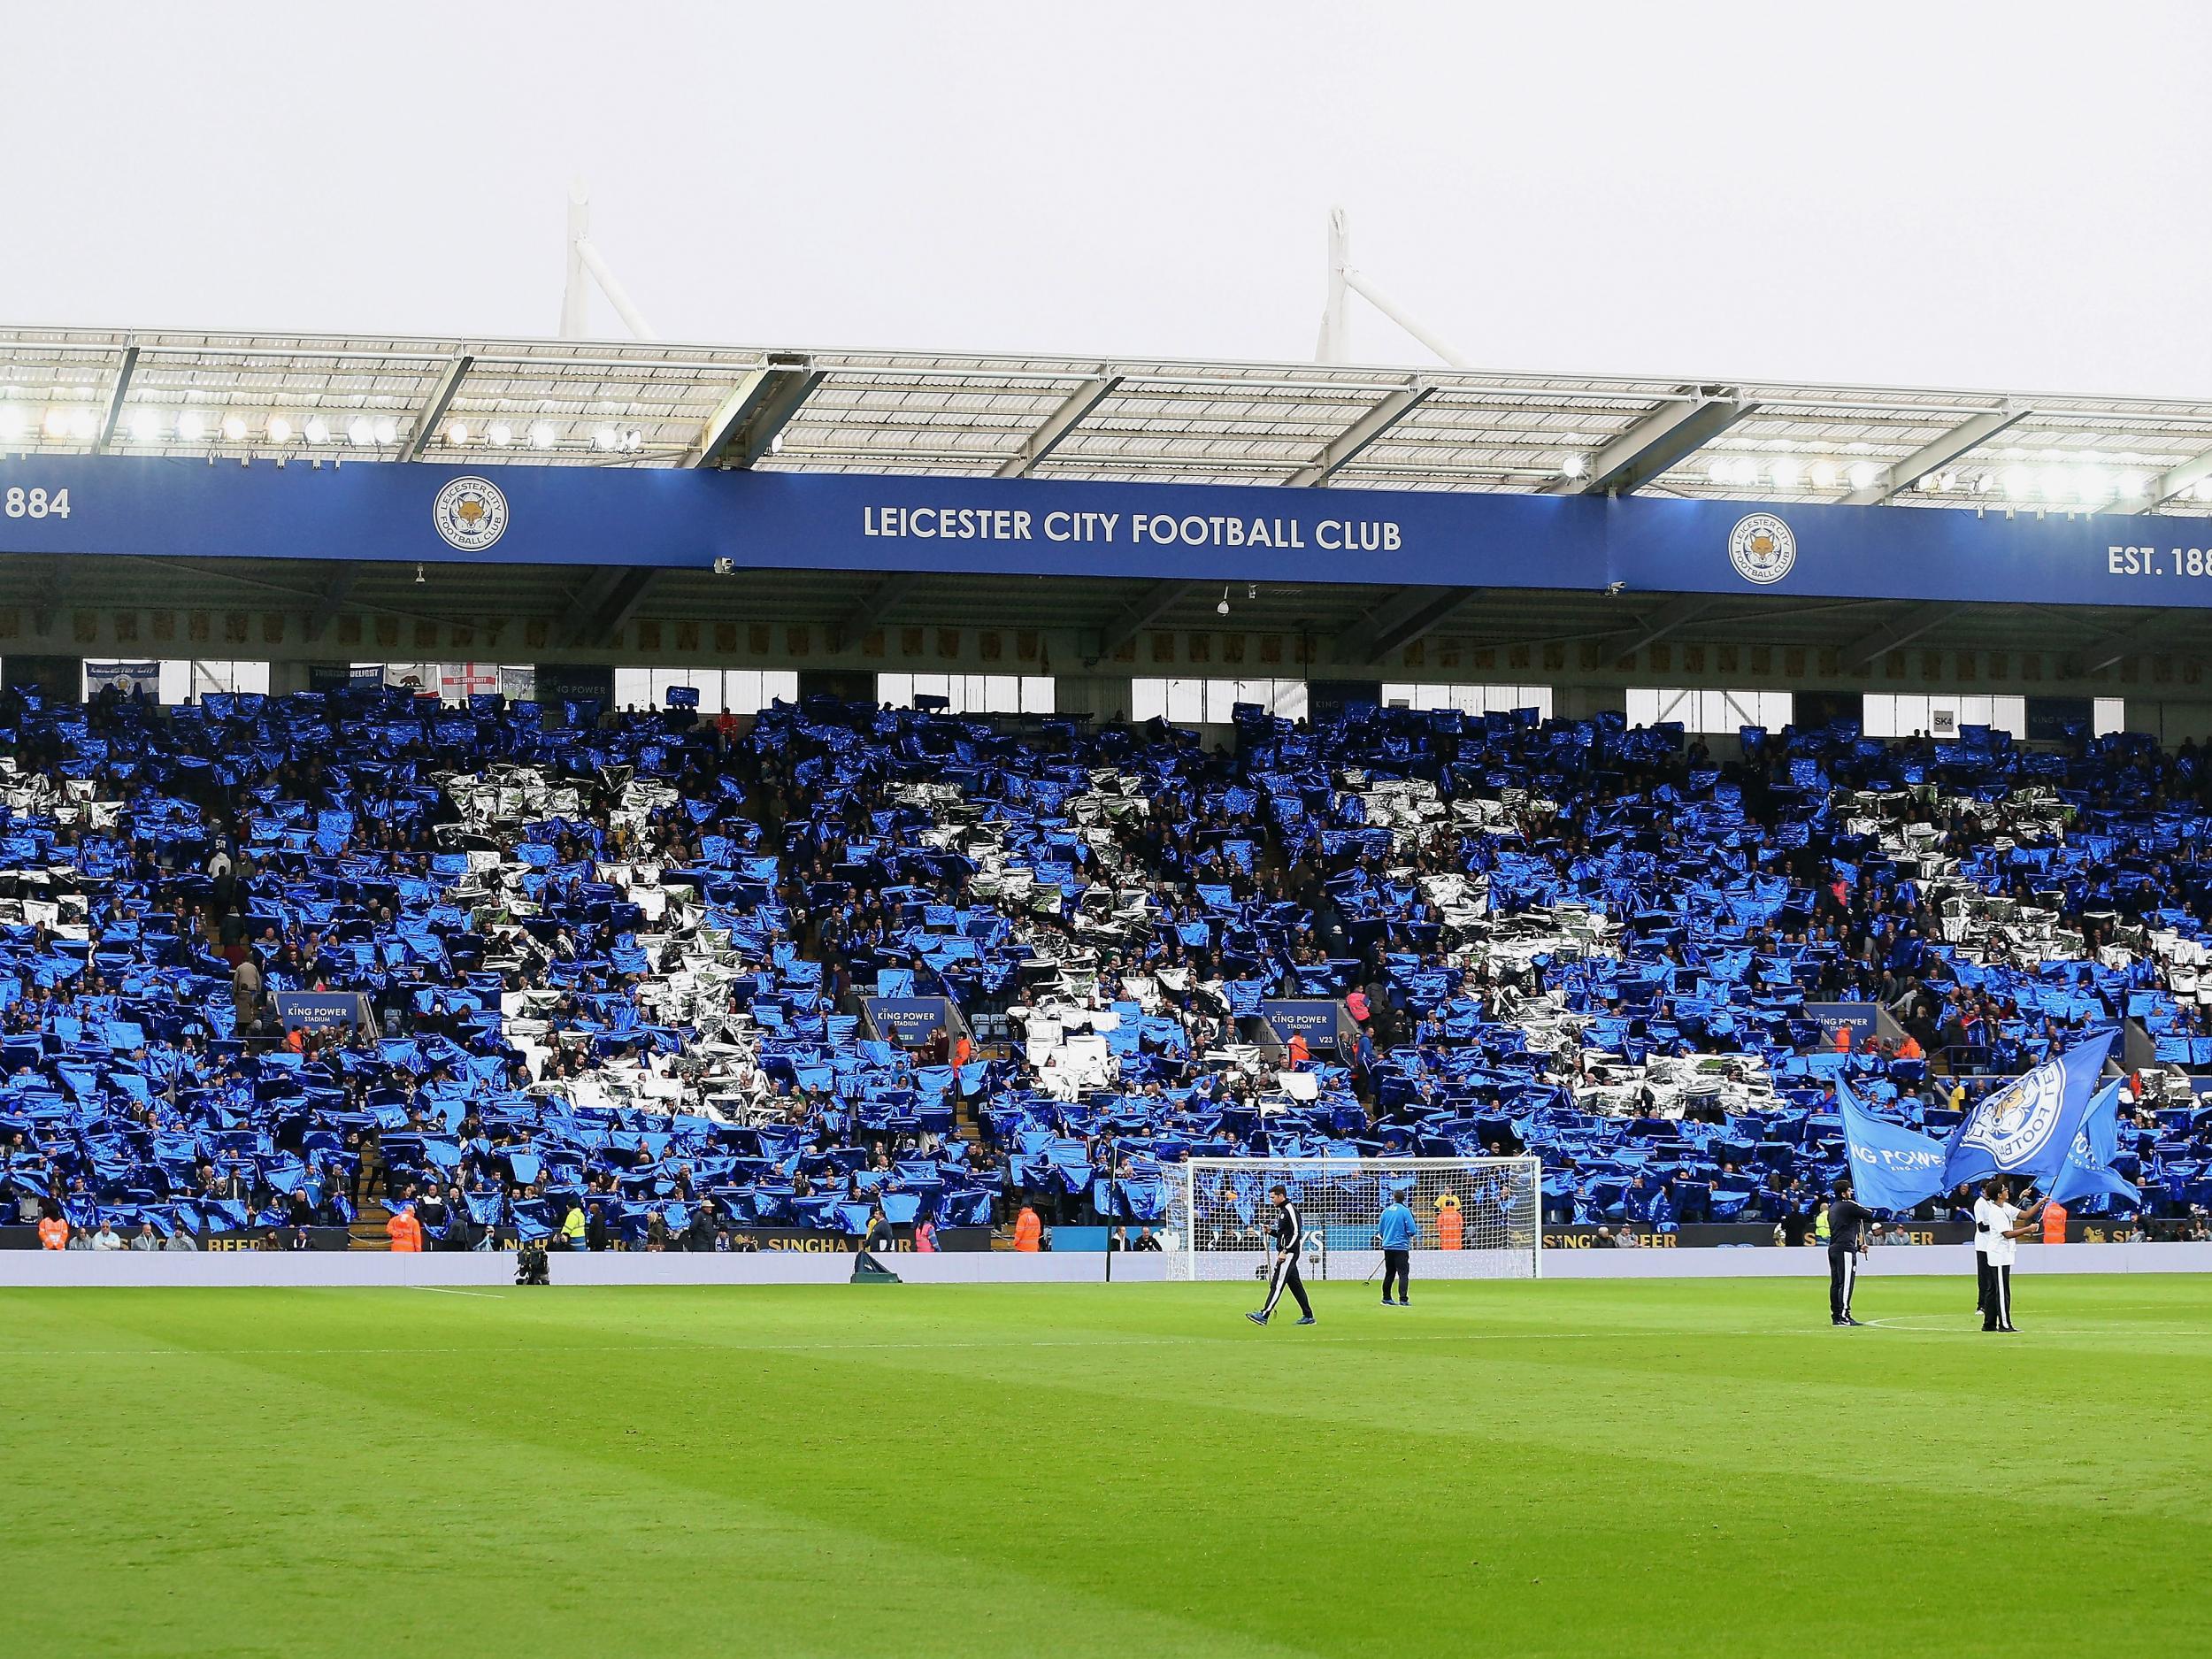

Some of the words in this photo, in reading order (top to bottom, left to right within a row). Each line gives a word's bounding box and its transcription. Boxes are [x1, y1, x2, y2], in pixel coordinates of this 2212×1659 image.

[441, 482, 488, 511] LEICESTER
[487, 490, 503, 512] CITY
[440, 516, 485, 545] FOOTBALL
[483, 517, 502, 541] CLUB
[864, 507, 1033, 540] LEICESTER
[1044, 511, 1119, 542] CITY
[1133, 514, 1305, 549] FOOTBALL
[1316, 520, 1402, 551] CLUB
[1735, 518, 1777, 545] LEICESTER
[1776, 526, 1791, 547] CITY
[1735, 550, 1775, 578] FOOTBALL
[1774, 551, 1790, 573] CLUB
[2108, 546, 2162, 575] EST.
[349, 669, 379, 678] DELIGHT
[572, 685, 606, 695] POWER
[1316, 700, 1339, 709] KING
[1935, 717, 1952, 726] SK4
[288, 1008, 312, 1017] KING
[314, 1008, 347, 1017] POWER
[903, 1012, 935, 1021] POWER
[1880, 1149, 1946, 1168] POWE
[768, 1238, 849, 1253] SINGHA
[1637, 1234, 1677, 1248] EER
